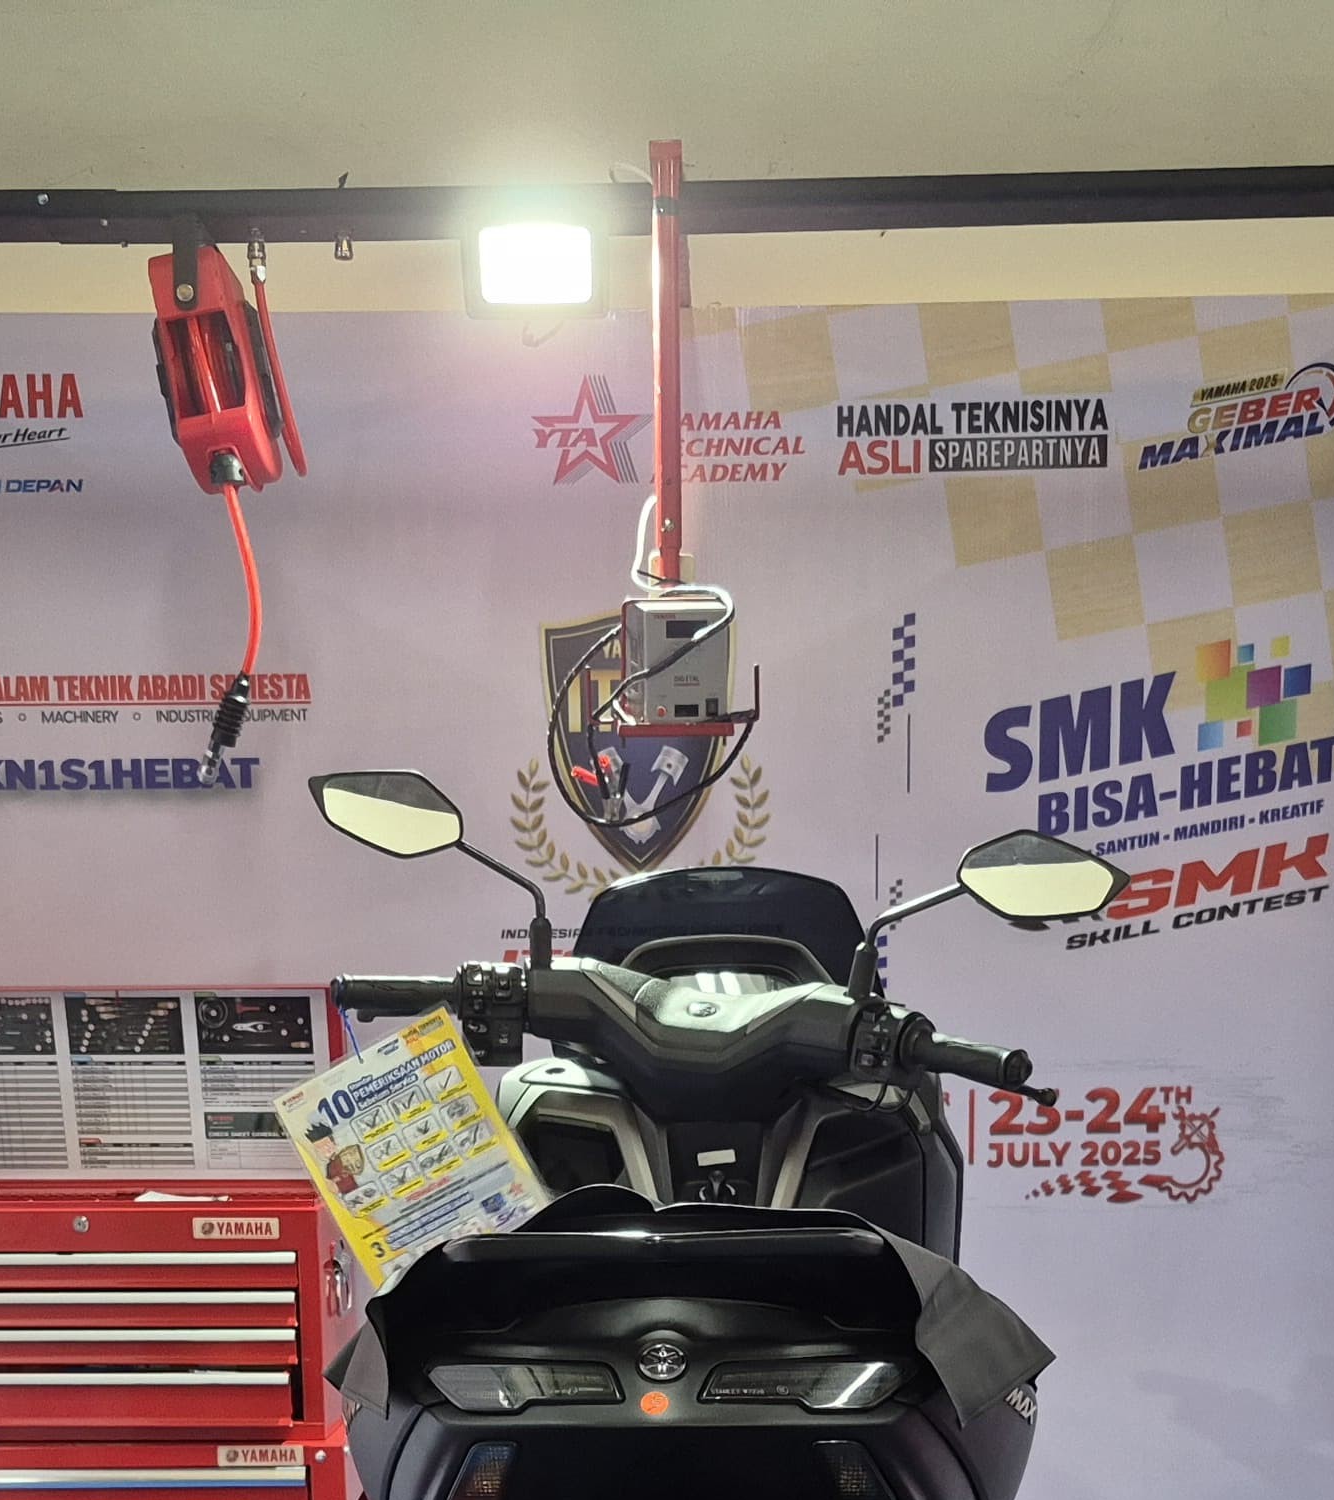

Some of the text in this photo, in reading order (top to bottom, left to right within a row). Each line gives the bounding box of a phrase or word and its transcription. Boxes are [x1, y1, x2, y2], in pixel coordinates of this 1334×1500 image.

[1201, 374, 1278, 401] YAMAHA 2025
[680, 411, 781, 431] AMAHA
[837, 399, 1108, 438] HANDAL TEKNISINYA
[1187, 387, 1321, 434] GEBER
[532, 428, 598, 449] YTA
[1138, 412, 1325, 470] MAXIMAL
[838, 436, 1101, 475] ASLI SPAREPARTNYA
[5, 478, 84, 493] DEPAN
[54, 675, 134, 702] TEKNIK
[138, 675, 206, 701] ABADI
[41, 710, 119, 724] MACHINERY
[244, 708, 307, 722] QUIPMENT
[984, 671, 1177, 793] SMK
[1095, 799, 1324, 857] SANTUN MANDIRI KREATIF
[1065, 885, 1329, 950] SKILL CONTEST
[420, 1041, 455, 1064] MOTOR
[318, 1089, 356, 1127] 10
[987, 1140, 1161, 1168] JULY 2025
[217, 1222, 272, 1235] YAMAHA
[241, 1449, 297, 1462] YAMAHA
